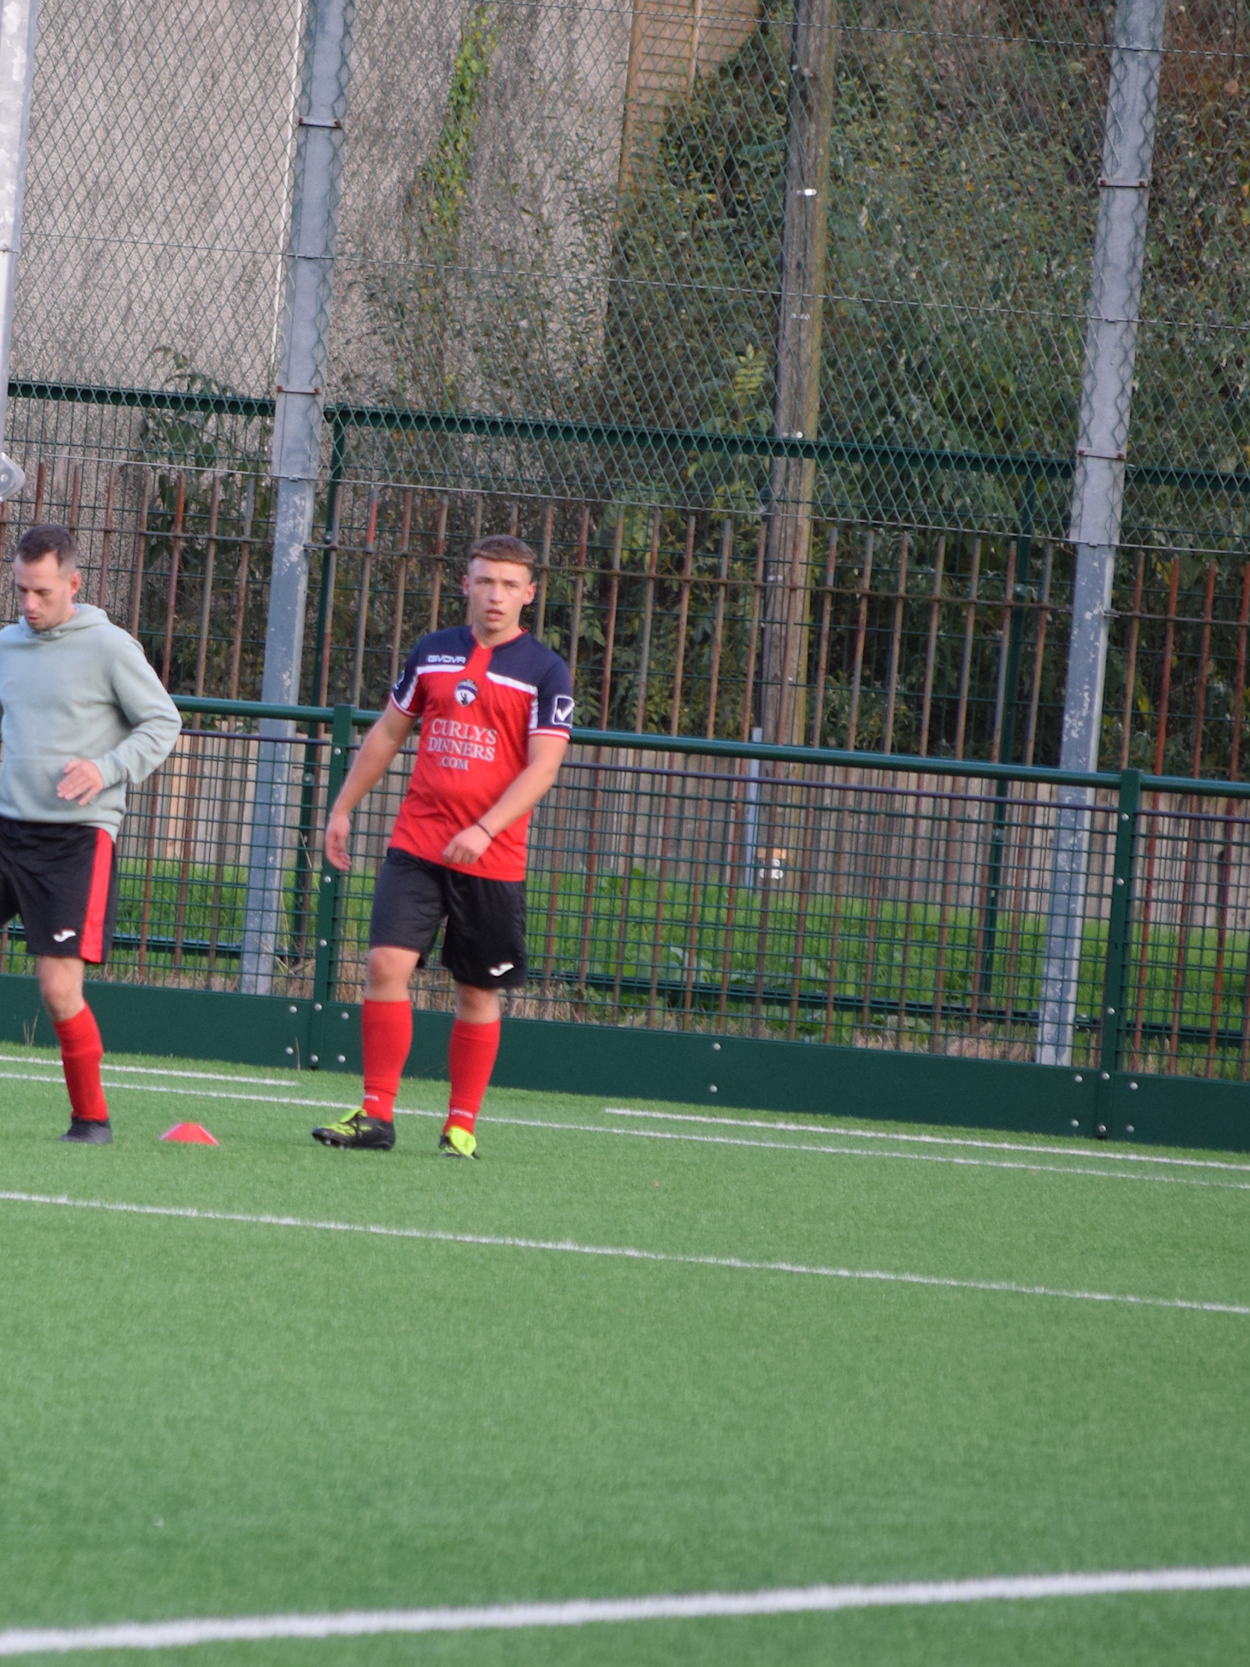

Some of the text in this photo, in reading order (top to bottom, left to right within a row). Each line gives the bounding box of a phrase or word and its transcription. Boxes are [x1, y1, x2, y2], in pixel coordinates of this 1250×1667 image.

[431, 718, 497, 745] CURLYS
[427, 736, 496, 761] DINNERS
[439, 756, 469, 771] .COM
